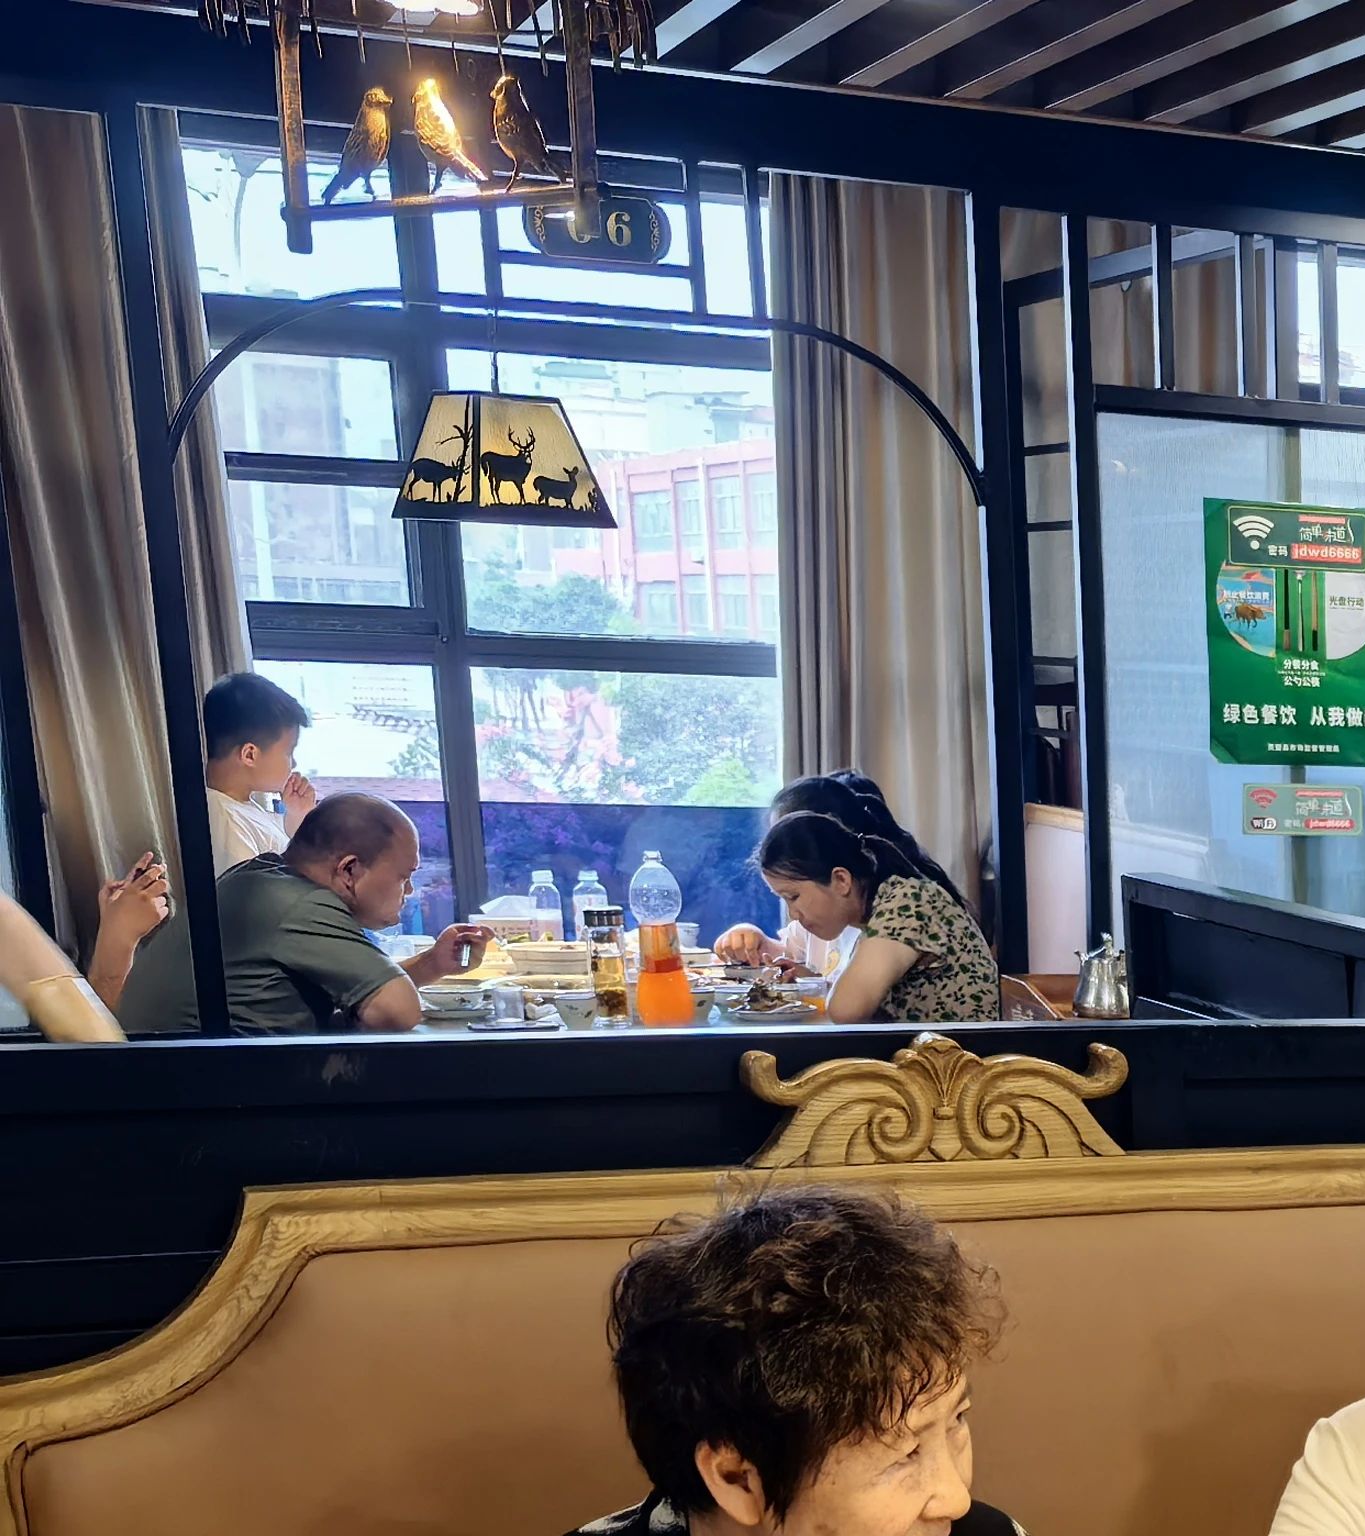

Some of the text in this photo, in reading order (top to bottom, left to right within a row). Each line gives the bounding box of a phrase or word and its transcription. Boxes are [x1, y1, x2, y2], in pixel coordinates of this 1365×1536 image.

[1295, 544, 1360, 560] jdwd6666
[1329, 595, 1365, 607] 光盘行动
[1223, 703, 1297, 726] 绿色餐饮
